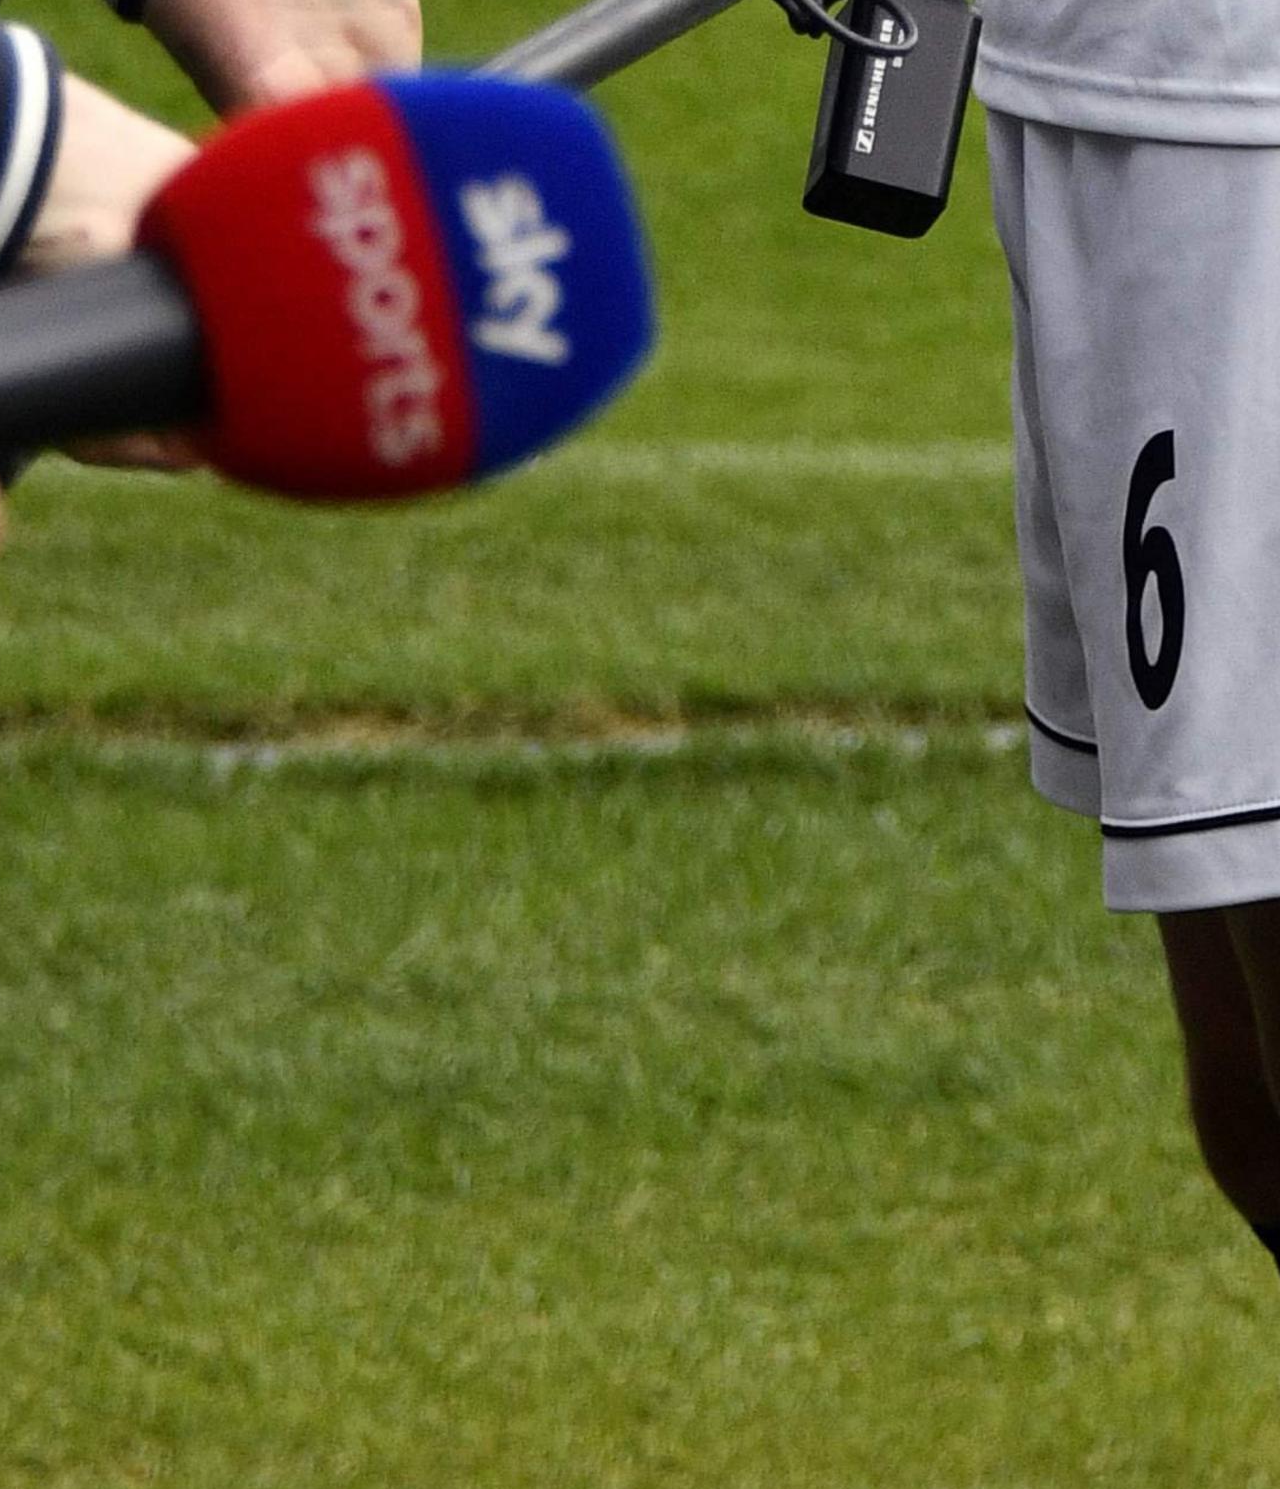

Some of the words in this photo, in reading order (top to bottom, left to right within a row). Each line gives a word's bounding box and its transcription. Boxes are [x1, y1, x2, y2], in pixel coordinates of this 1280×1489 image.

[862, 18, 895, 128] SENNHEER
[305, 145, 446, 466] sports
[457, 170, 573, 368] sky
[1123, 429, 1185, 711] 6
